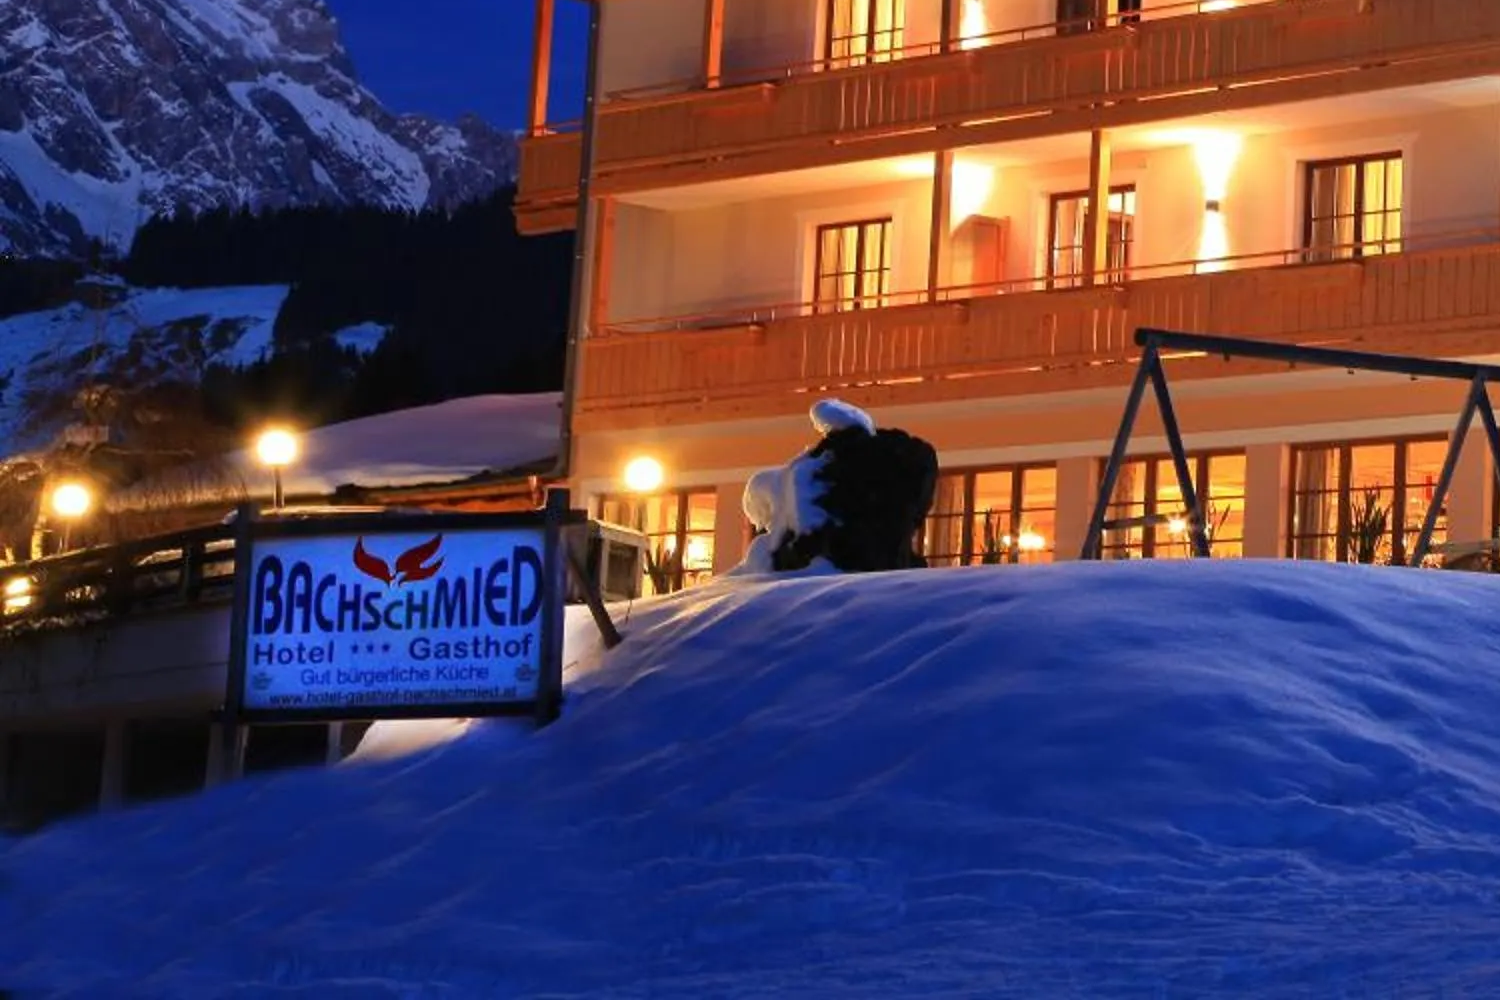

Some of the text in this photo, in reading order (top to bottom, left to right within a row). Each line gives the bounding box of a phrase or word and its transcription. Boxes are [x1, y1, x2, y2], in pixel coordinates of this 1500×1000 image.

[254, 633, 533, 665] Hotel Gasthof
[301, 668, 331, 686] Gut
[436, 663, 489, 681] Küche
